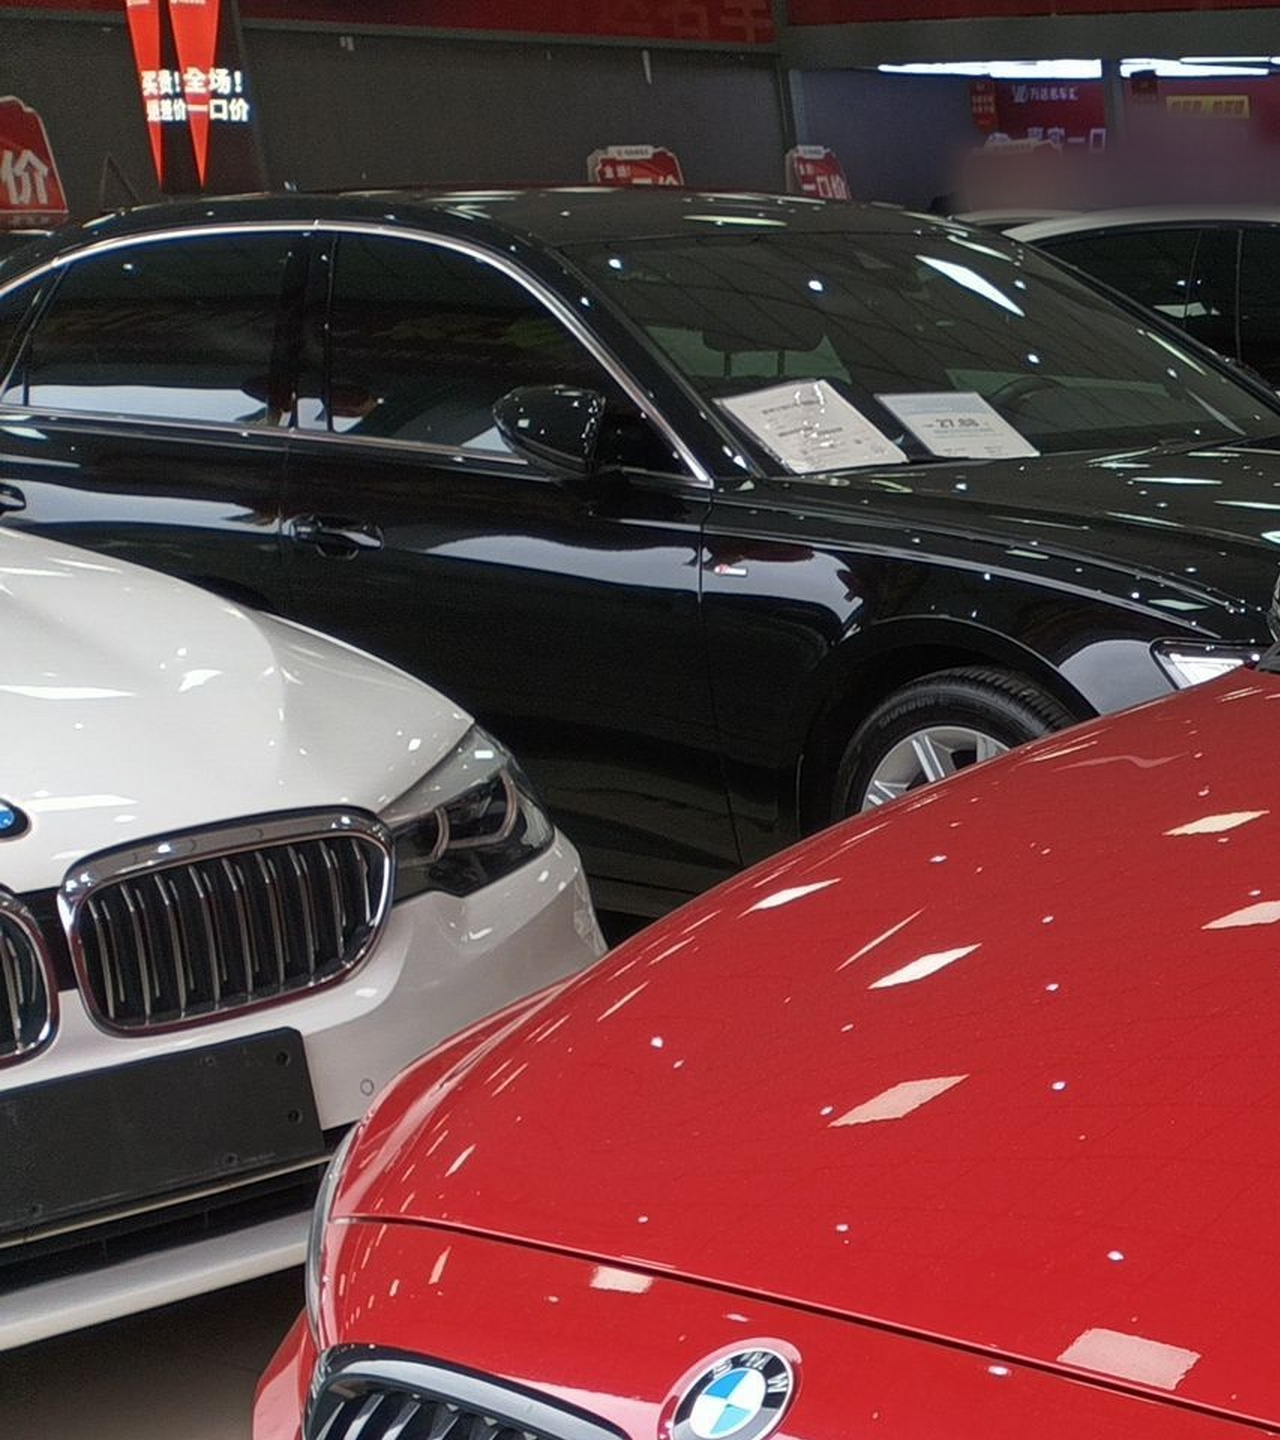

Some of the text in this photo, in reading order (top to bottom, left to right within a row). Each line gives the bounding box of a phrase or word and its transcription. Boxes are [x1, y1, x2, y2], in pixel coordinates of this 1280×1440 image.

[183, 66, 243, 95] 全场!
[187, 97, 250, 122] 一口价
[712, 1350, 790, 1394] BMW
